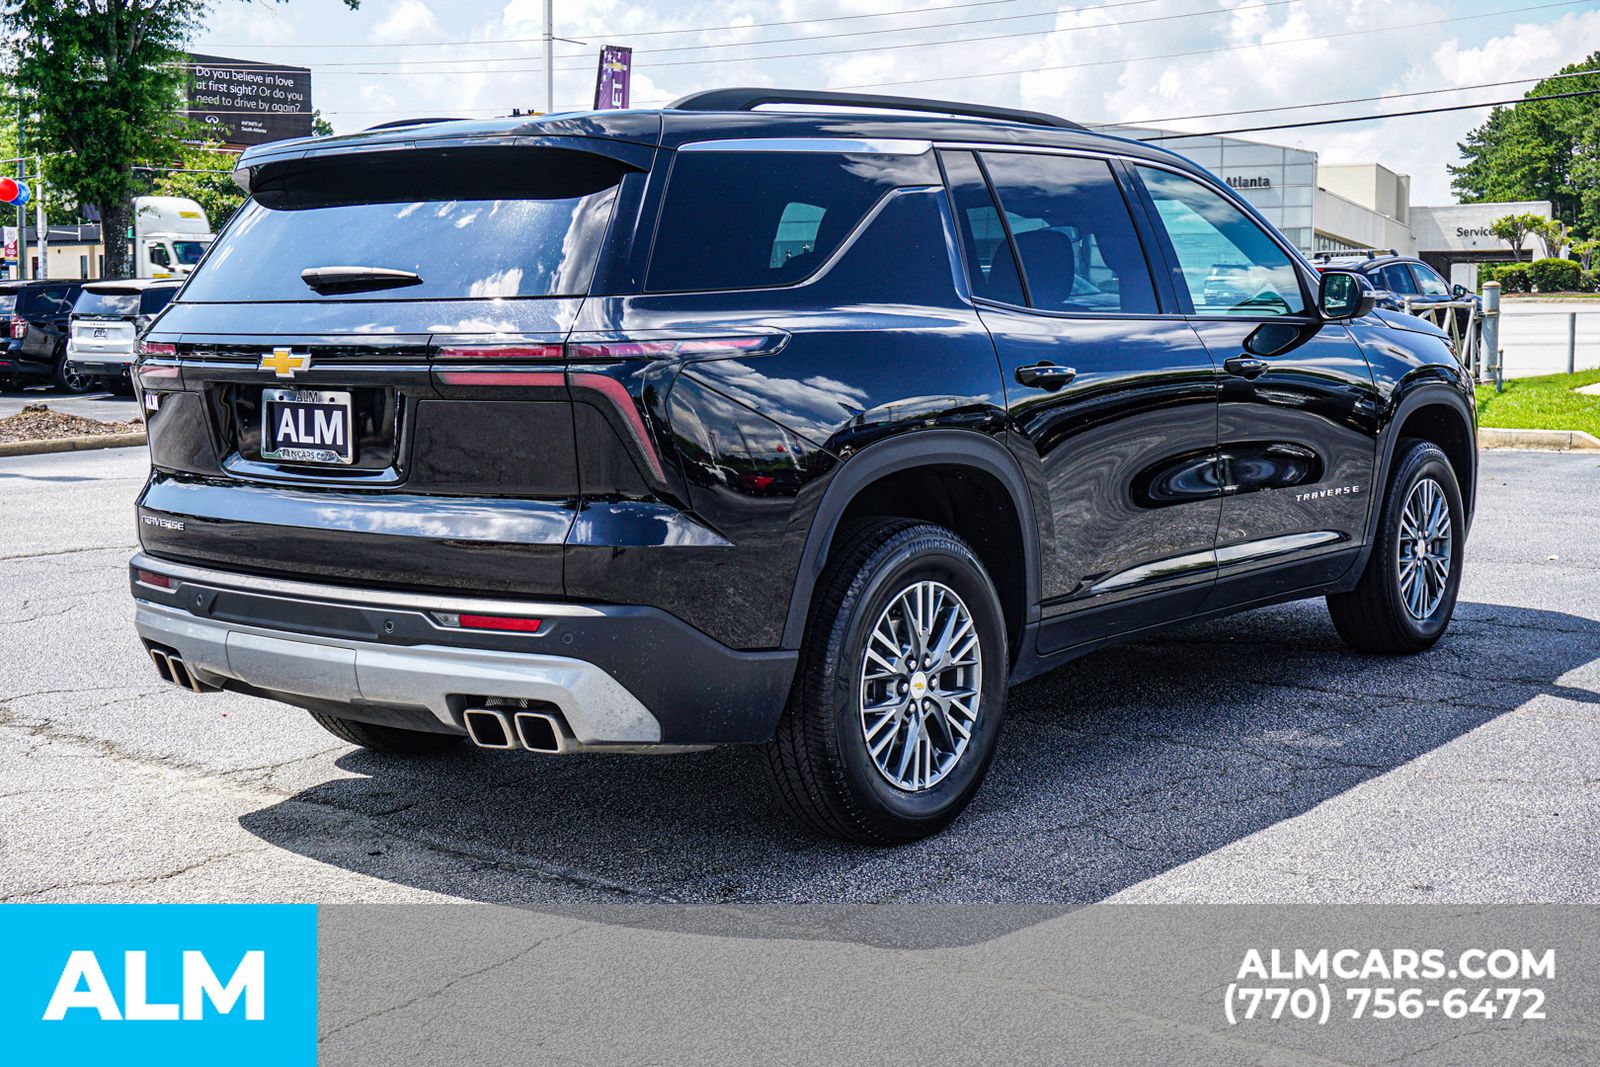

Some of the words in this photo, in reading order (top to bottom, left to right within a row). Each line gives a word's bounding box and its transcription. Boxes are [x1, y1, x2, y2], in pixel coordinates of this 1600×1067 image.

[196, 66, 210, 77] Do
[212, 70, 230, 80] you
[232, 70, 263, 83] believe
[265, 74, 274, 85] in
[275, 75, 294, 87] love
[196, 81, 206, 90] at
[208, 80, 228, 92] first
[229, 83, 257, 96] sight?
[259, 86, 271, 97] Or
[273, 88, 285, 99] do
[286, 92, 303, 102] you
[611, 78, 623, 109] ET
[196, 95, 220, 105] need
[221, 96, 232, 106] to
[234, 97, 256, 108] drive
[258, 99, 270, 112] by
[271, 103, 301, 113] again?
[1226, 176, 1270, 187] Atlanta
[1456, 226, 1496, 238] Service
[295, 390, 319, 403] ALM
[276, 407, 344, 446] ALM
[1295, 485, 1361, 502] TRAVERSE
[141, 515, 185, 531] TRAVERSE
